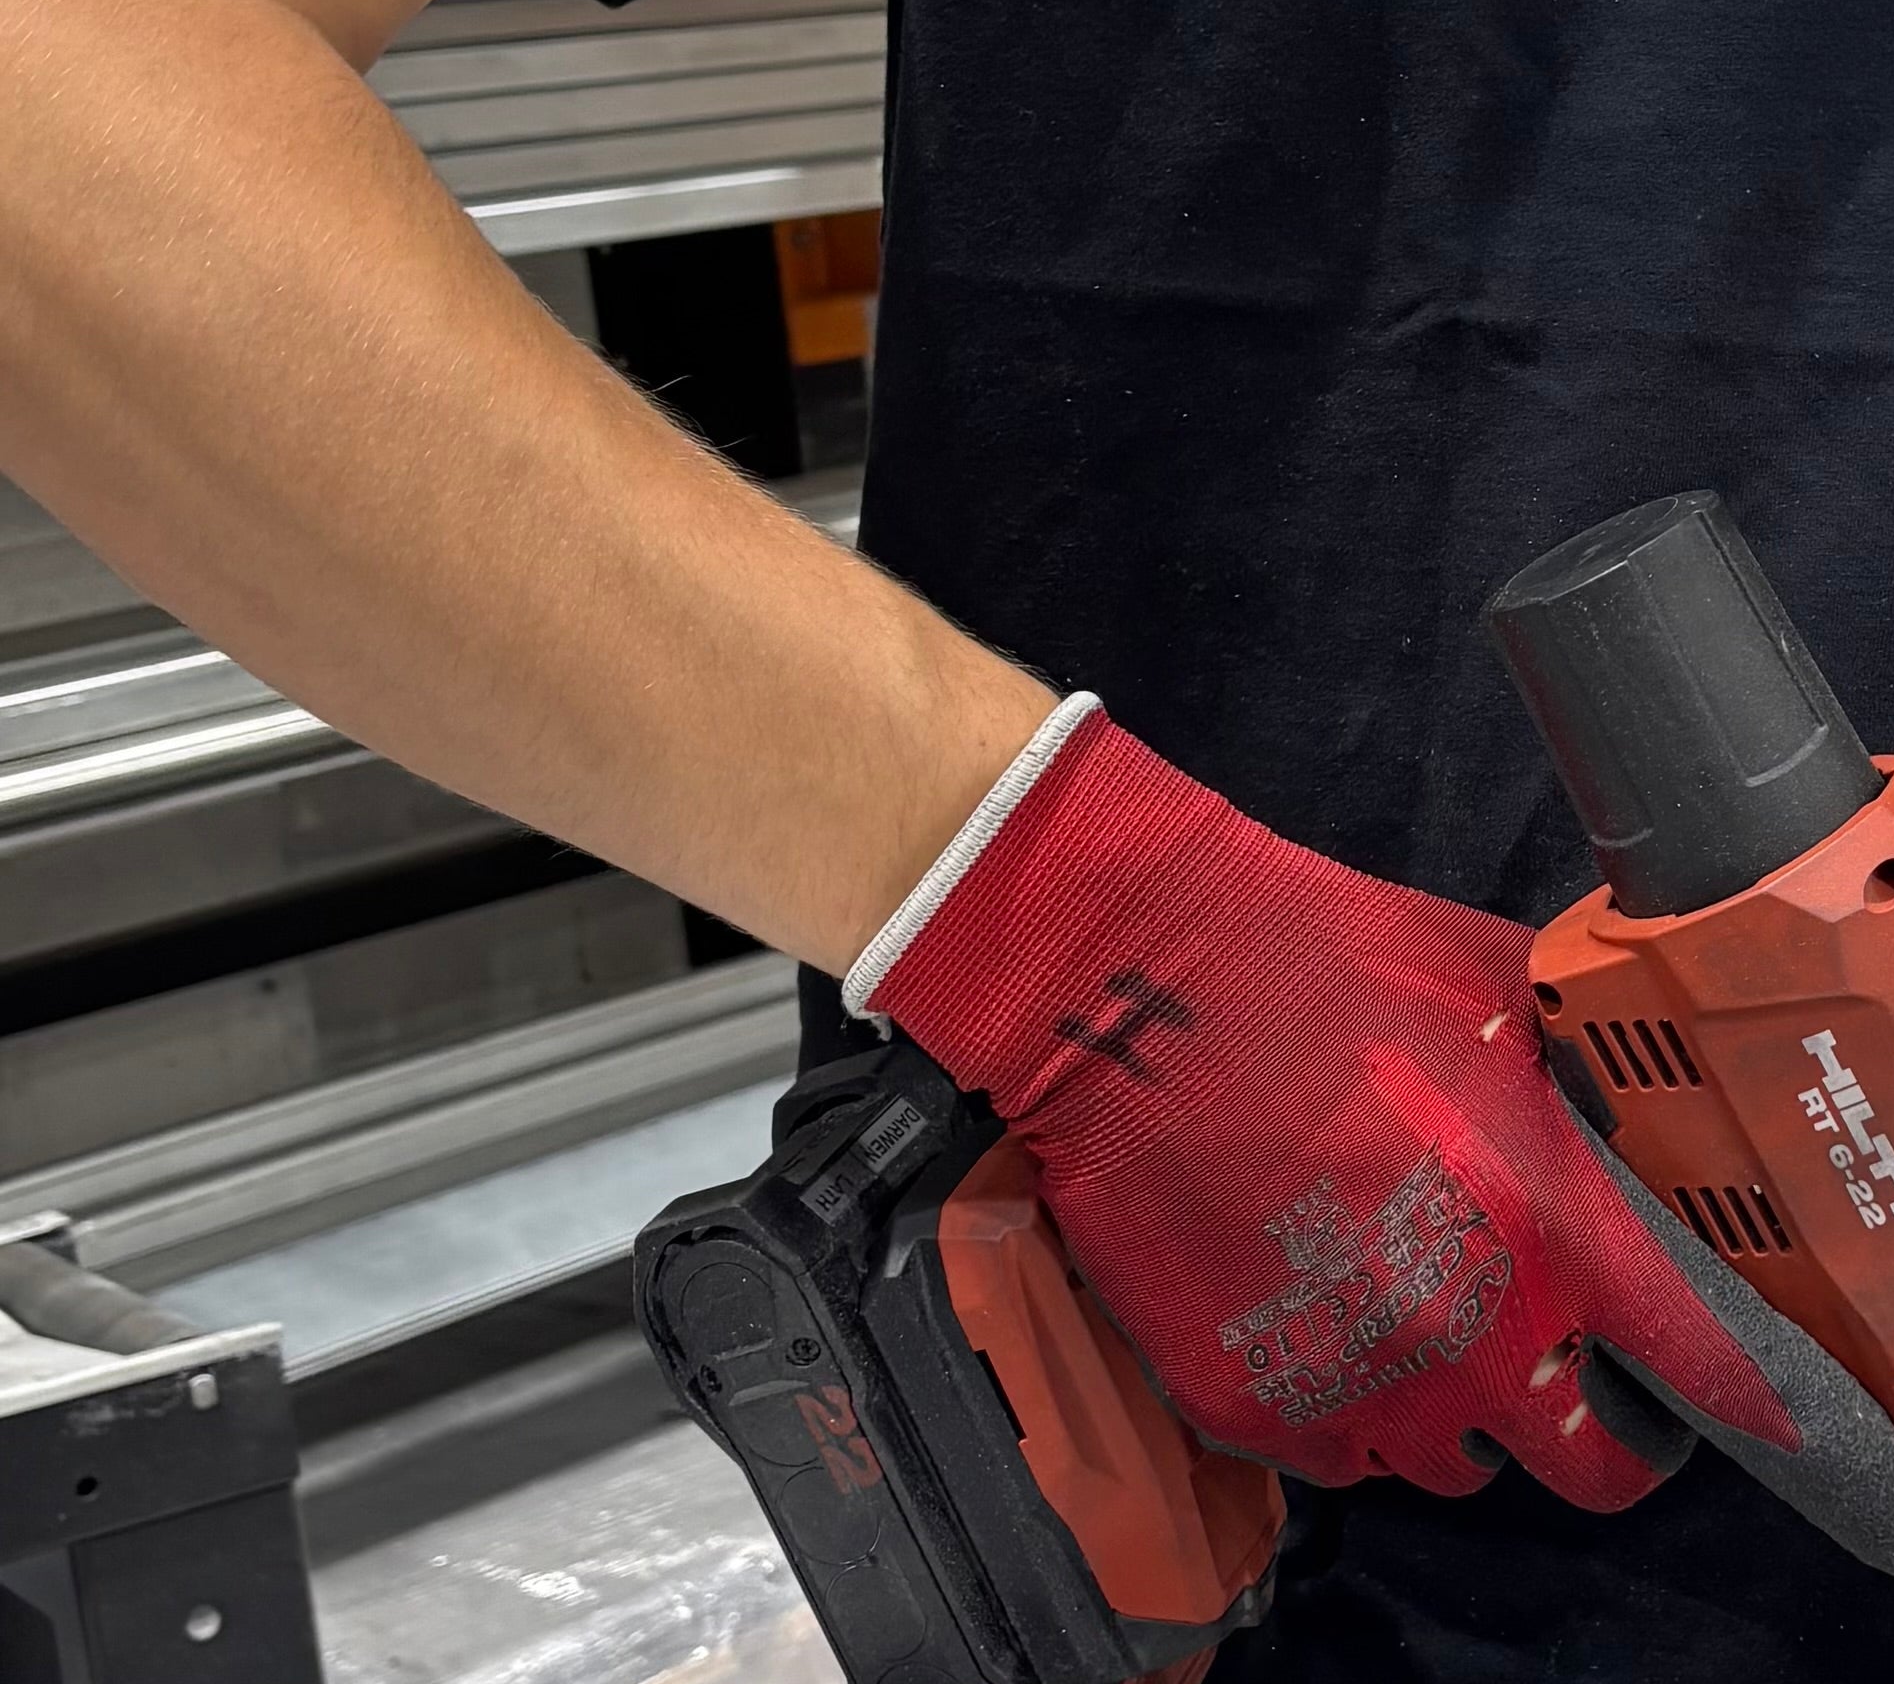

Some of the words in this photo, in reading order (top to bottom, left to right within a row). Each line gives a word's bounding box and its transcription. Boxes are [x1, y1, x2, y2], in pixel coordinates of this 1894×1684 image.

[862, 1105, 922, 1164] DARWEN
[1797, 1087, 1840, 1132] RT
[1829, 1144, 1887, 1230] 6-22
[794, 1384, 883, 1496] 22
